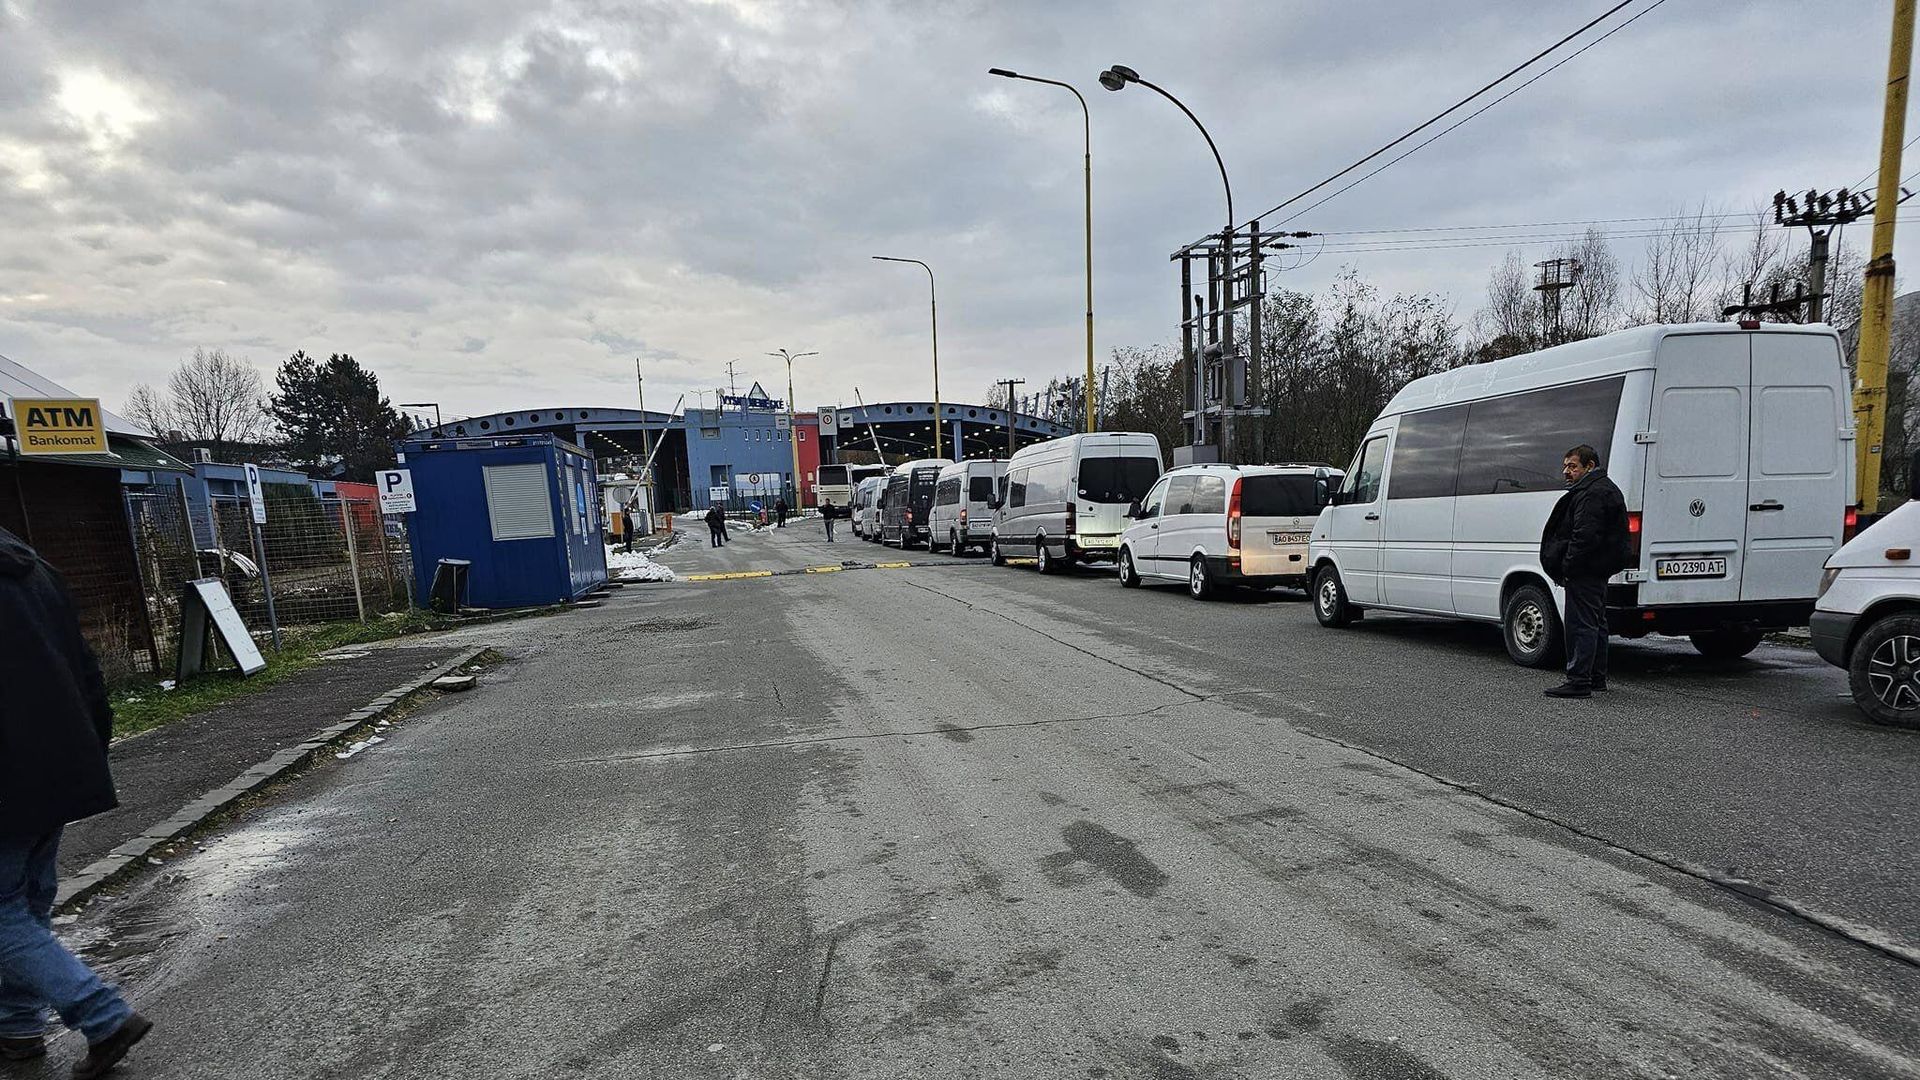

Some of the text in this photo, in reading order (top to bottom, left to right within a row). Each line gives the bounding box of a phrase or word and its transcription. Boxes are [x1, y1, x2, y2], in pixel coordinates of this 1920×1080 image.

[26, 407, 94, 427] ATM
[28, 435, 97, 446] Bankomat
[248, 466, 258, 496] P
[385, 472, 403, 493] P
[1665, 561, 1722, 574] AO 2390 AT
